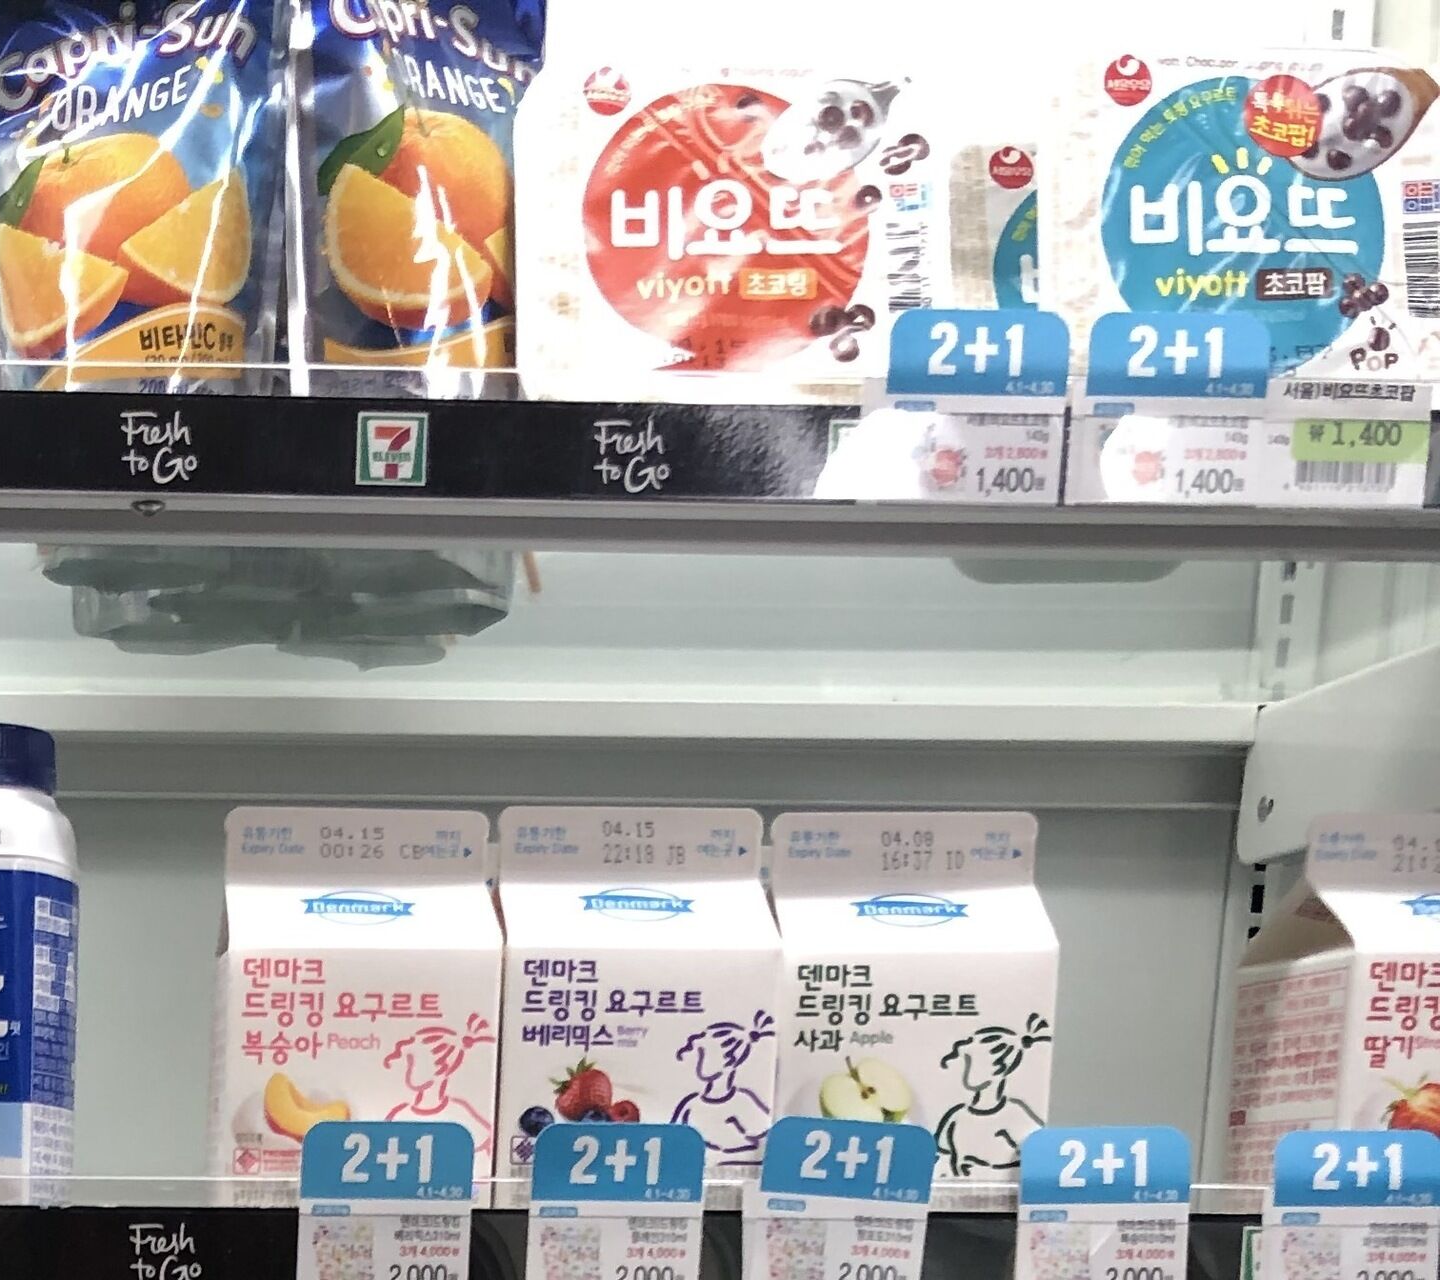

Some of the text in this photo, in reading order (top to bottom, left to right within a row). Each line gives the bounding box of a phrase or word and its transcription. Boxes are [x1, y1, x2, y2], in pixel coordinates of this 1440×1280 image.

[610, 179, 843, 261] 비요뜨
[1130, 173, 1359, 256] 비요뜨
[1265, 272, 1327, 296] 초코팝
[928, 323, 1024, 377] 2+1
[1128, 326, 1224, 378] 2+1
[242, 957, 326, 985] 덴마크
[242, 992, 442, 1027] 드링킹 요구르트
[241, 1033, 381, 1066] 복숭아 Peach
[522, 1025, 614, 1053] 베리믹스
[794, 1030, 894, 1053] 사과 Apple
[341, 1136, 433, 1184] 2+1
[1059, 1141, 1150, 1188] 2+1
